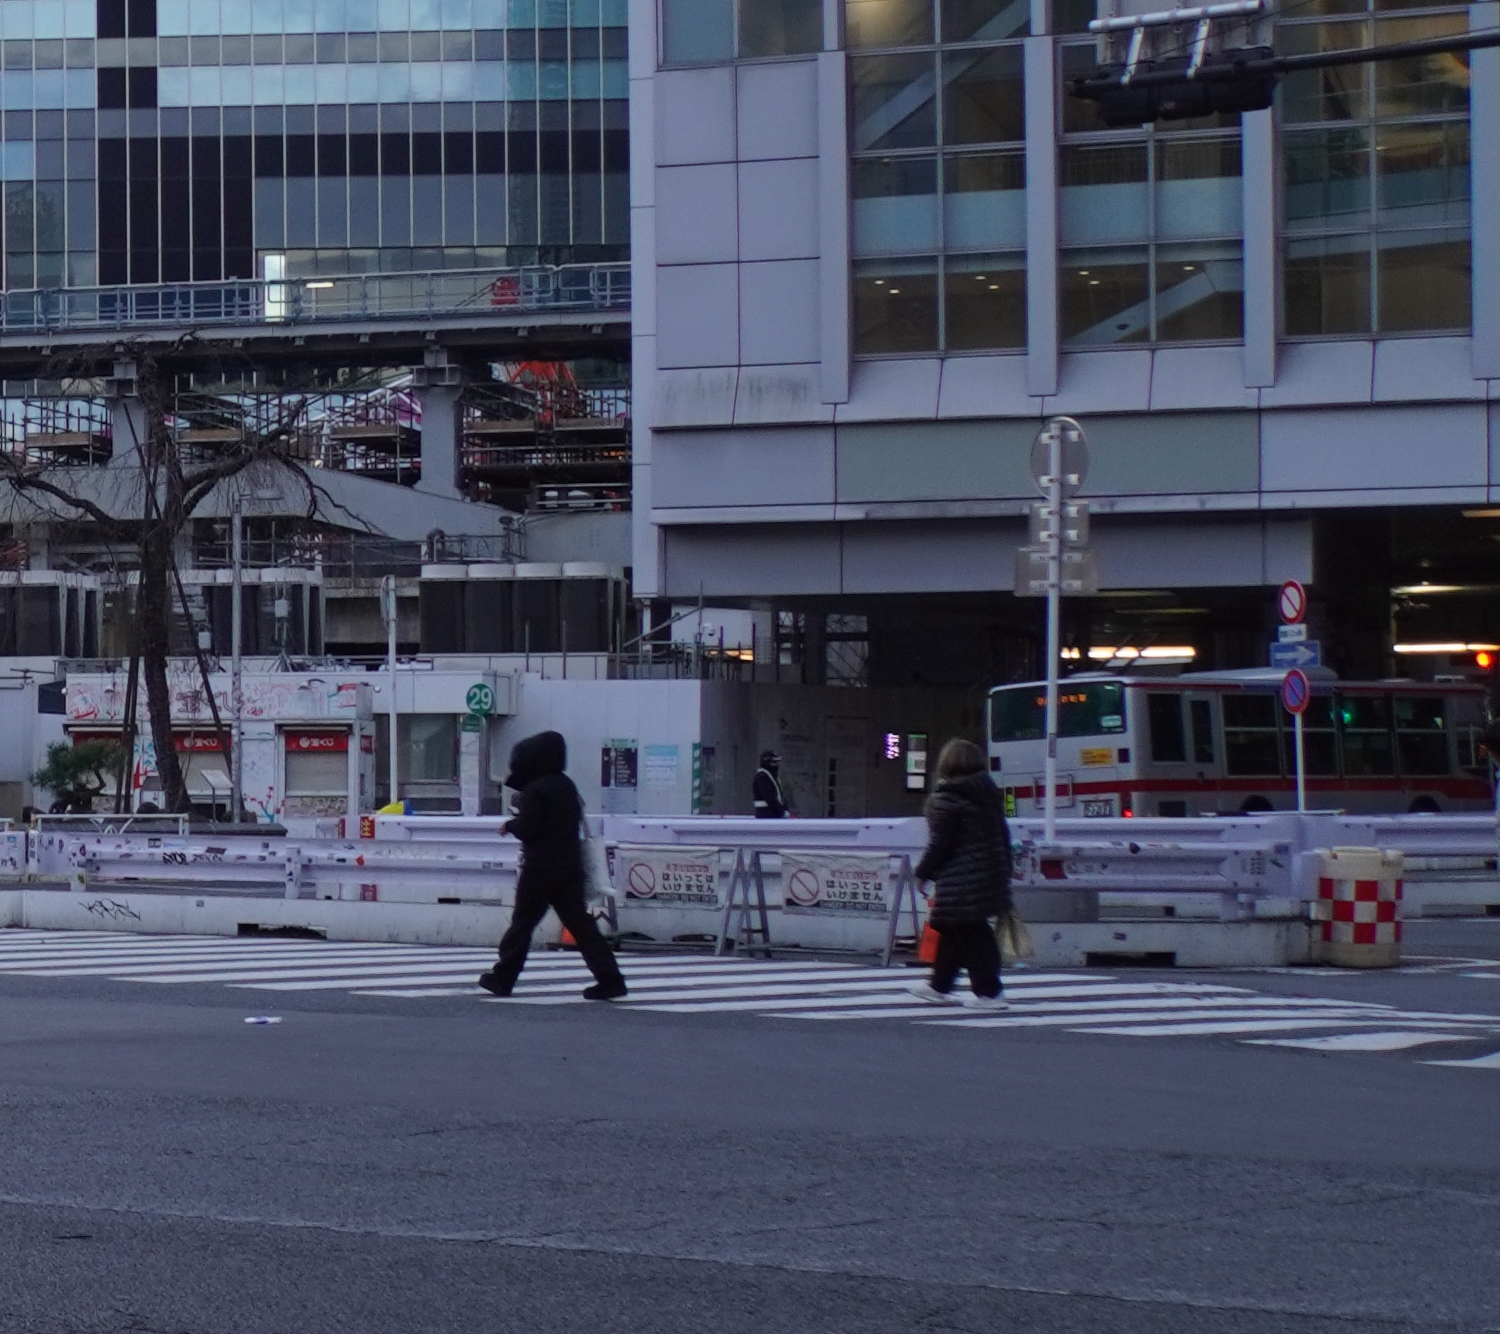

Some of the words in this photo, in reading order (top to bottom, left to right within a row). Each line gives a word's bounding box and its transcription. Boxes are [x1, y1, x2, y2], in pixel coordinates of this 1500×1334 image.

[469, 687, 492, 710] 29
[662, 872, 714, 883] はいっては
[662, 882, 715, 893] いけません
[826, 880, 883, 891] はいっては
[826, 890, 884, 902] いけません
